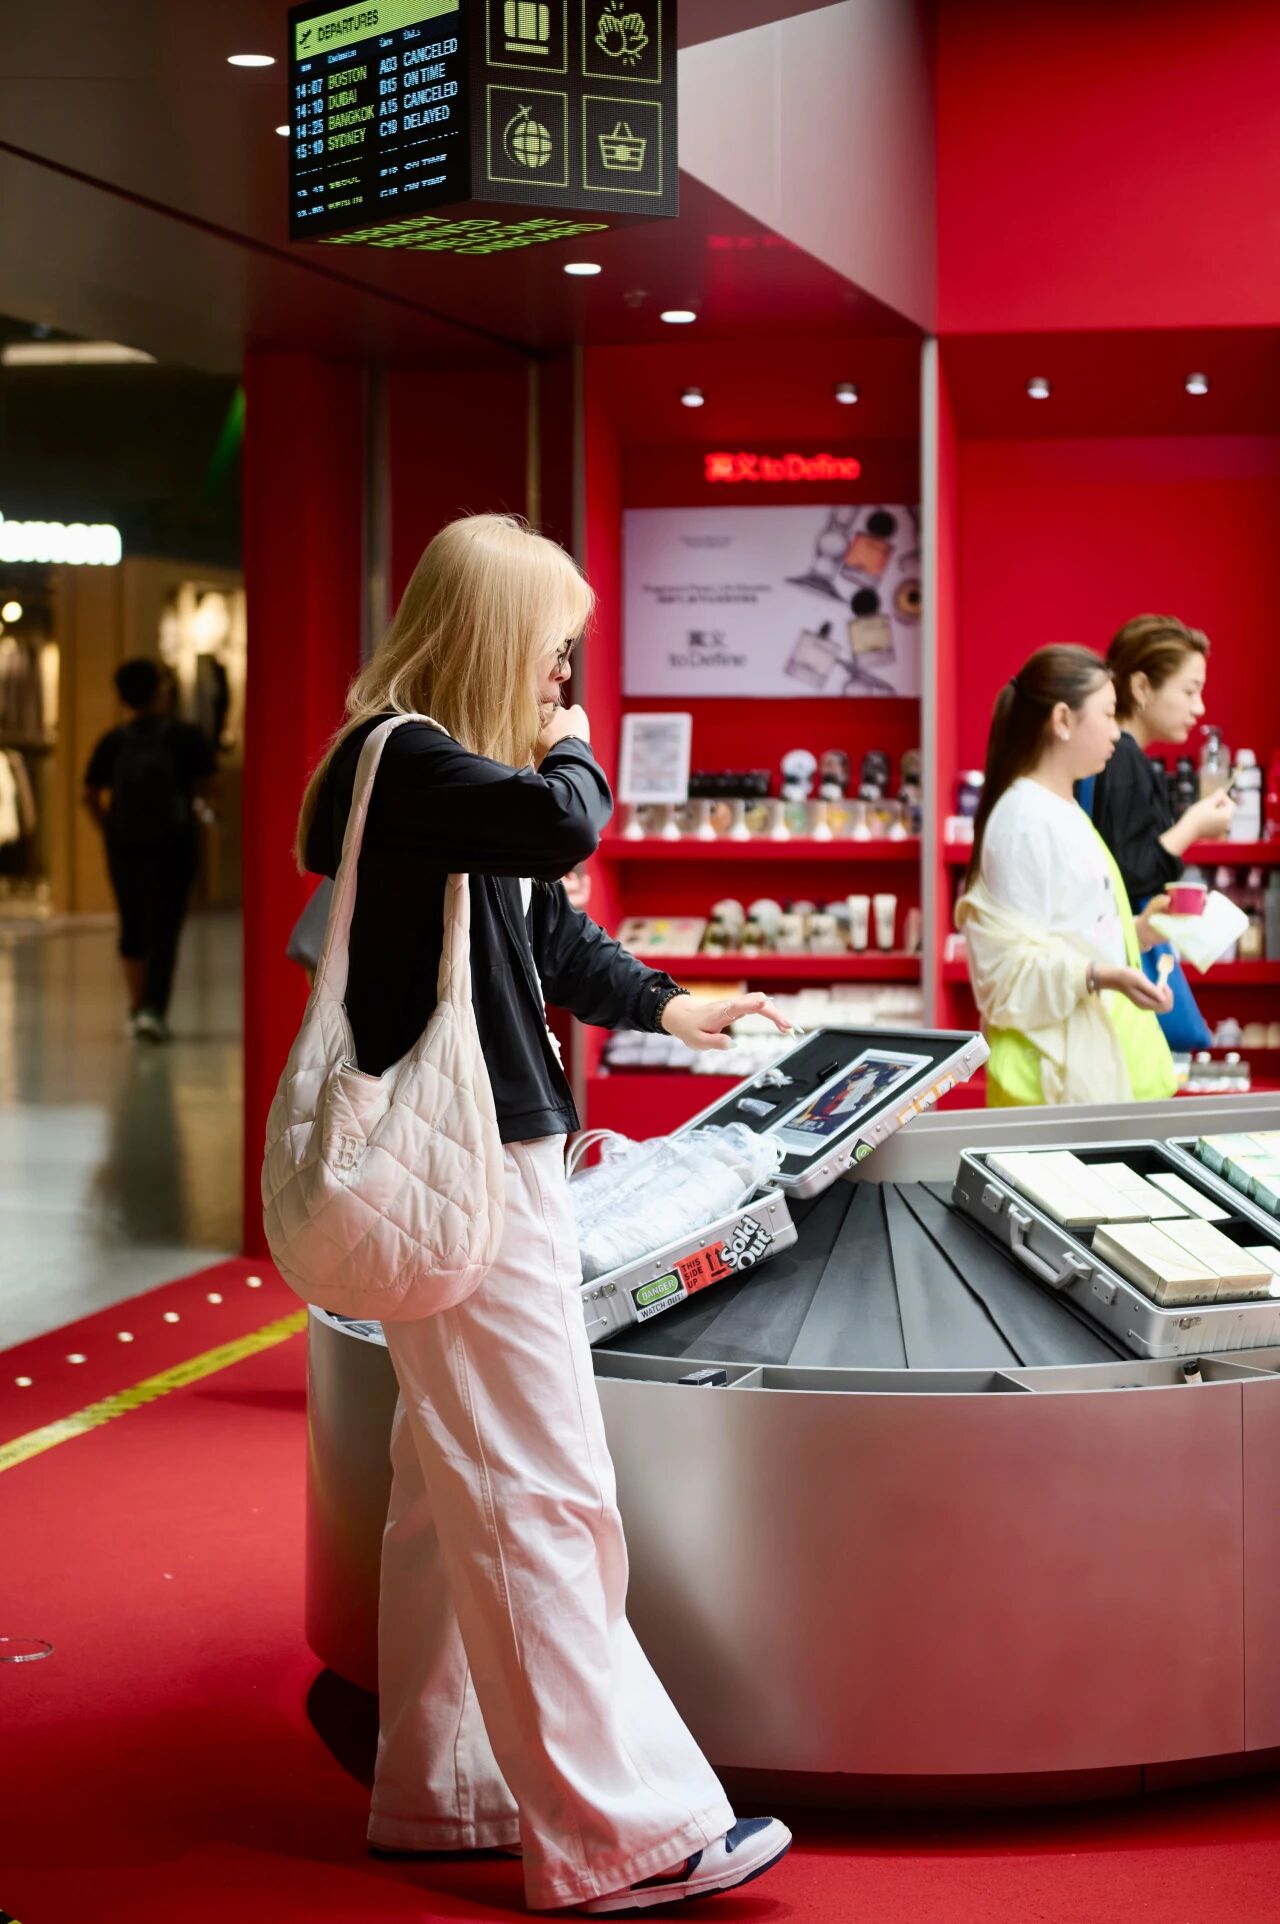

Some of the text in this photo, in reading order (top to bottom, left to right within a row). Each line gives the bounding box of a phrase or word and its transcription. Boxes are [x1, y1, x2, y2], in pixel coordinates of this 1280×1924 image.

[318, 9, 379, 41] DEPARTURES
[296, 78, 323, 99] 14:07
[327, 65, 367, 90] BOSTON
[403, 38, 458, 67] CANCELED
[295, 99, 324, 119] 14:10
[328, 89, 357, 110] DUBAI
[403, 70, 419, 88] ON
[420, 62, 445, 83] TIME
[295, 119, 324, 139] 14:25
[328, 104, 375, 131] BANGKOK
[403, 81, 458, 109] CANCELED
[295, 139, 324, 160] 15:10
[327, 128, 366, 151] SYDNEY
[403, 105, 450, 130] DELAYED
[318, 216, 450, 244] HARMAY
[406, 218, 574, 251] WELCOME
[455, 223, 610, 254] ONBOARD
[720, 1214, 760, 1268] Sold
[736, 1228, 773, 1271] Out
[681, 1257, 701, 1272] THIS
[684, 1266, 704, 1281] SIDE
[642, 1279, 675, 1300] DANGER
[687, 1278, 699, 1290] UP
[641, 1291, 685, 1318] WATCH OUT!
